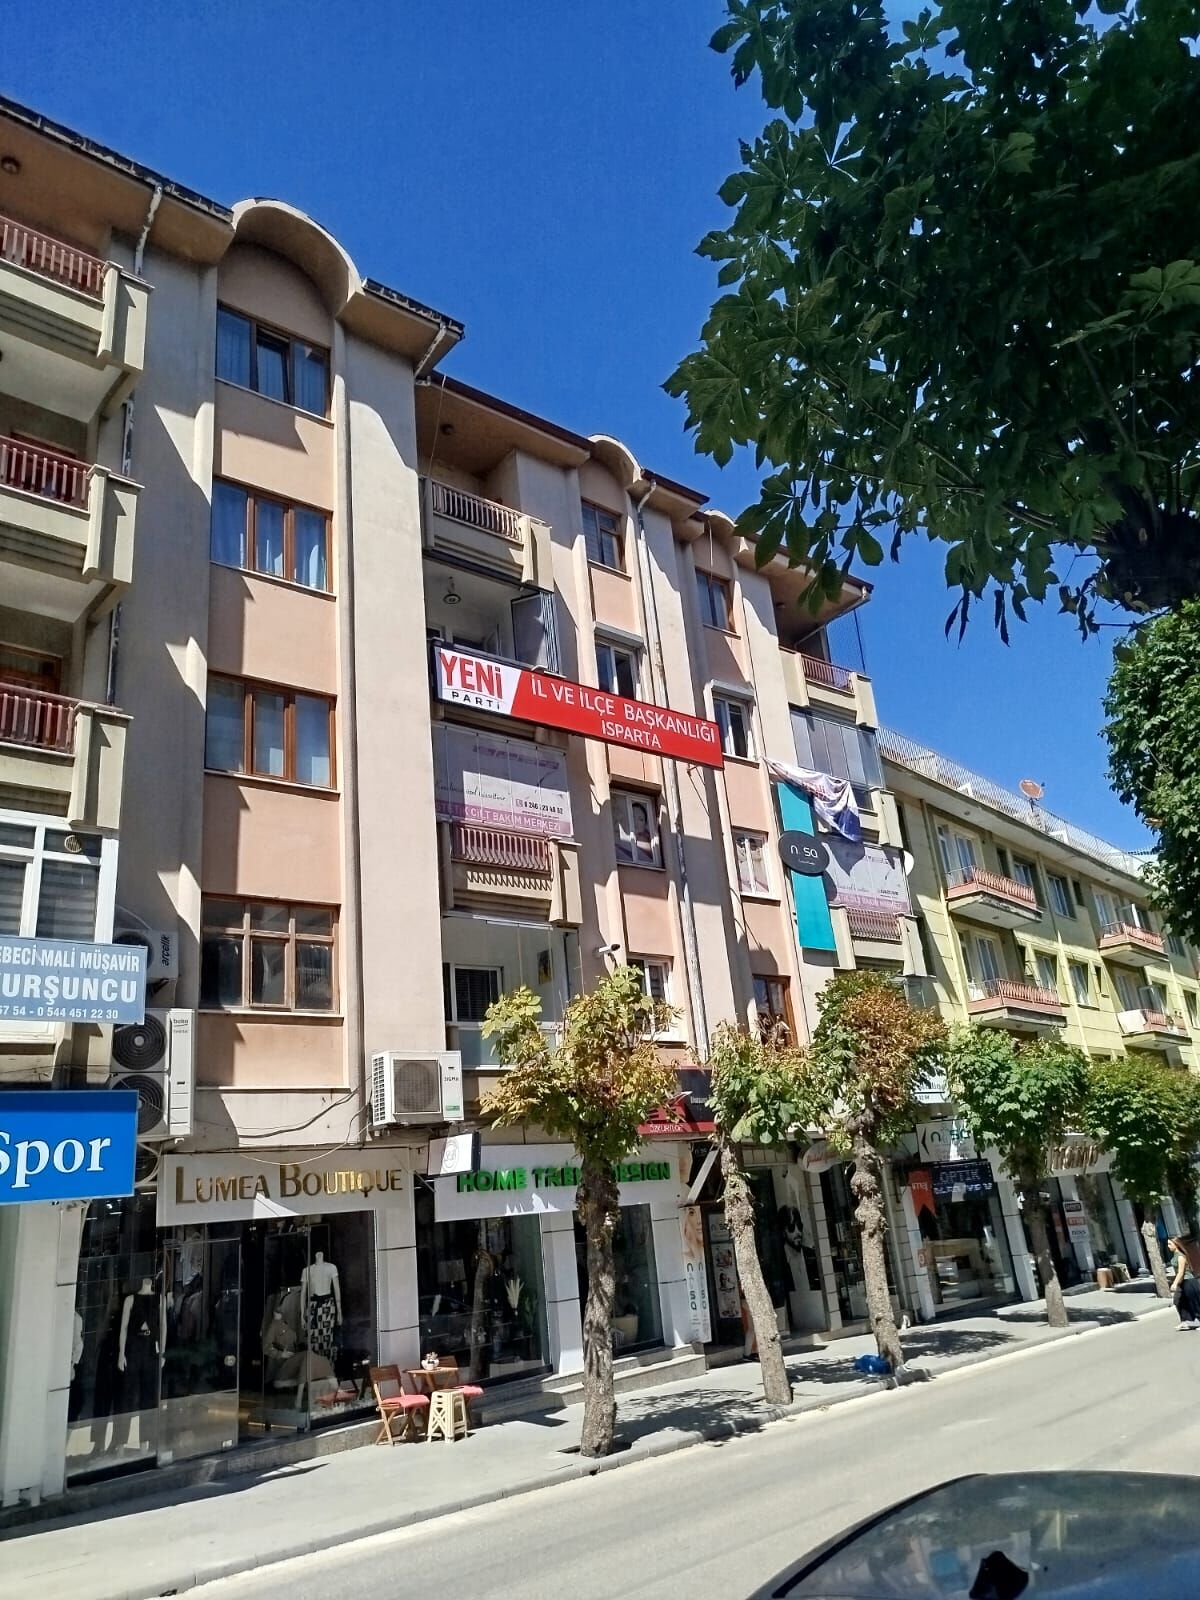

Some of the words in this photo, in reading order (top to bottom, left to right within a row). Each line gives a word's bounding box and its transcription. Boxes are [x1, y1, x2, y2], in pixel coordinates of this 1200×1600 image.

[531, 674, 548, 699] İL
[550, 682, 575, 705] VE
[579, 687, 615, 717] İLÇE
[624, 703, 715, 744] BAŞKANLIĞI
[601, 719, 662, 749] ISPARTA
[790, 844, 819, 858] nsa
[0, 944, 37, 966] BECİ
[40, 947, 76, 968] MALİ
[80, 949, 140, 975] MÜŞAVİR
[0, 972, 137, 1005] URŞUNCU
[12, 1005, 26, 1016] 54
[37, 1006, 44, 1017] 0
[46, 1007, 66, 1018] 544
[69, 1007, 87, 1018] 451
[90, 1008, 103, 1019] 22
[106, 1009, 119, 1019] 30
[456, 1167, 528, 1193] HOME
[531, 1166, 582, 1189] TRE
